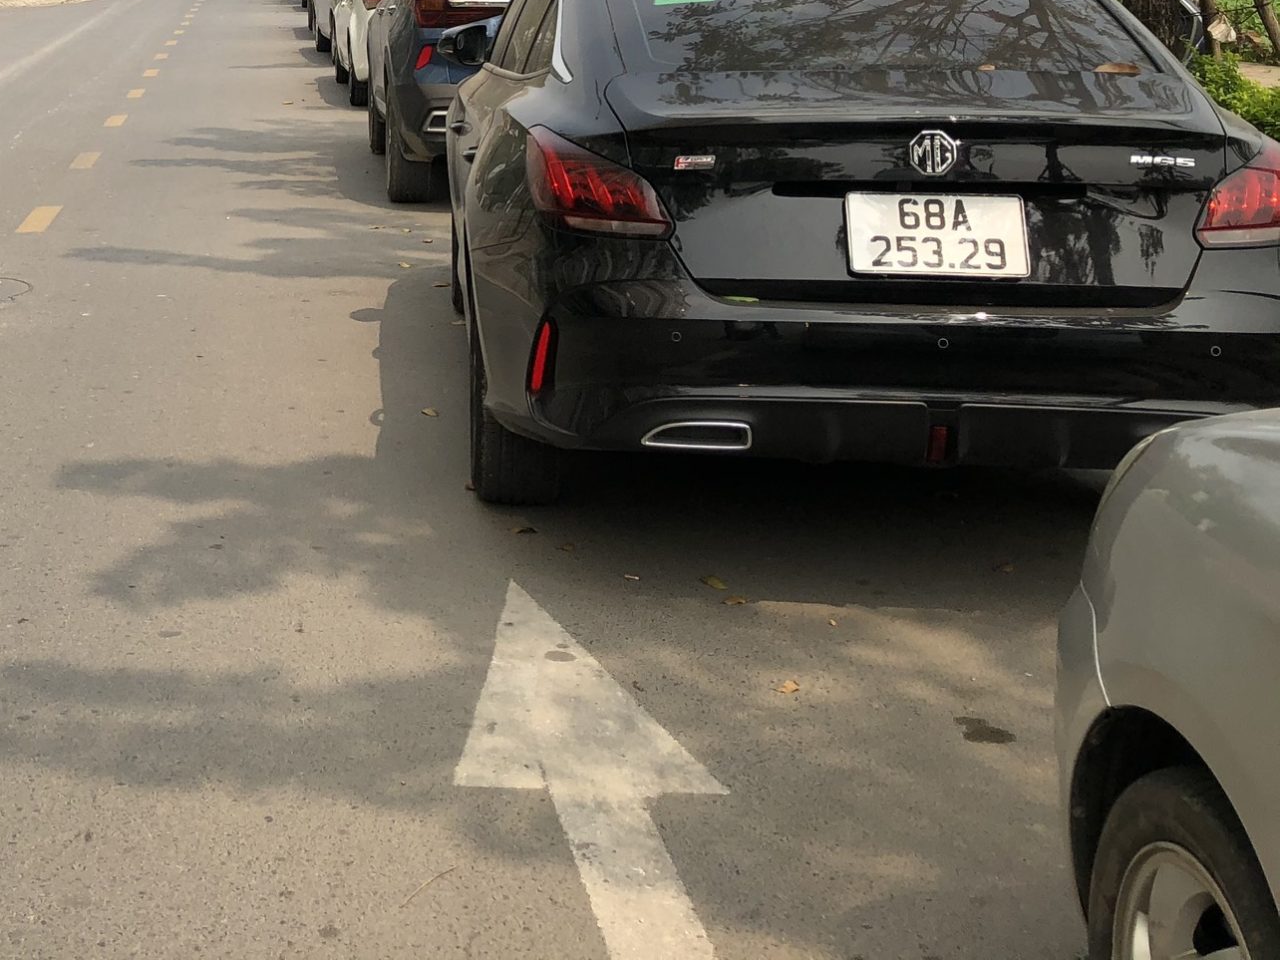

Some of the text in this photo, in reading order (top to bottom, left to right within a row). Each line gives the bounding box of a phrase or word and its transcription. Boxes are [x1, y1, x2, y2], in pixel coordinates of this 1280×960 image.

[913, 135, 953, 173] MG
[1130, 155, 1196, 167] MG5
[897, 198, 972, 231] 68A
[870, 235, 1007, 270] 253.29
